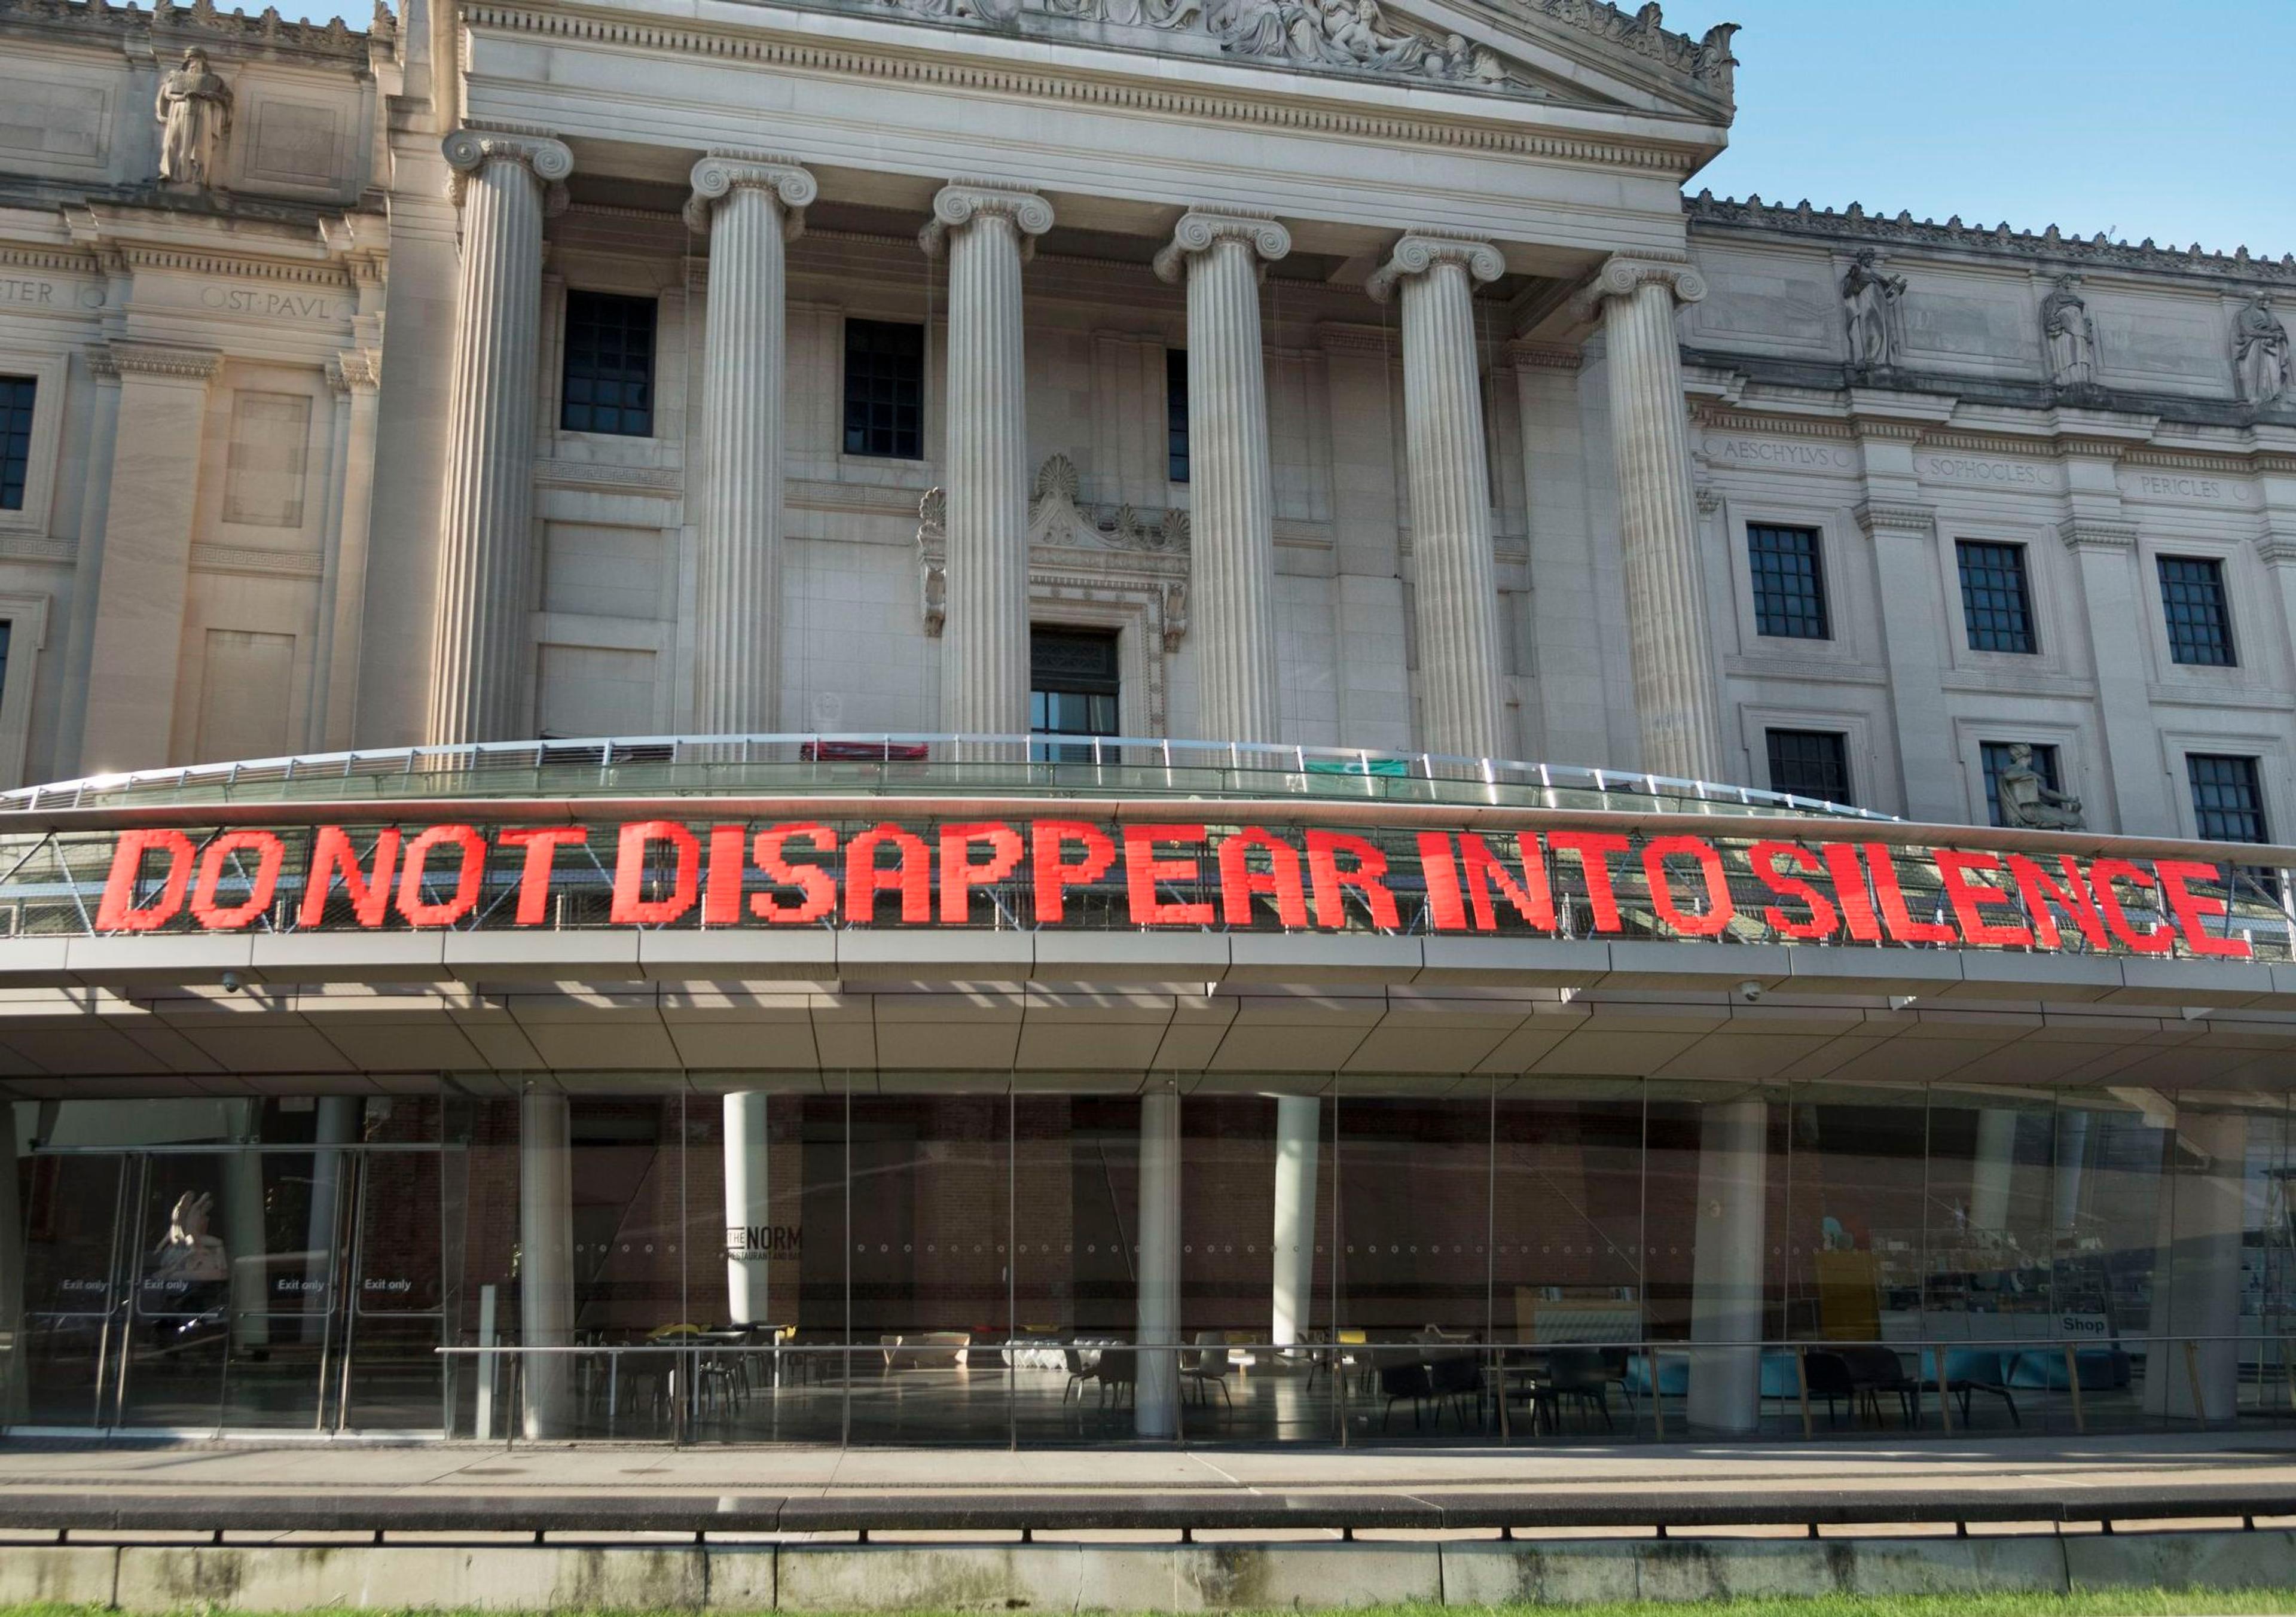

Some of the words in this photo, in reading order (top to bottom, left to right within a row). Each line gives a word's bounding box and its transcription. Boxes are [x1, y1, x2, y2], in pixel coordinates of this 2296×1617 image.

[0, 279, 53, 303] TER
[1724, 441, 1829, 466] AESCHYLVS
[1930, 458, 2036, 483] SOPHOCLES
[2139, 476, 2221, 499] PERICLES
[96, 829, 286, 930] DO
[300, 825, 588, 929] NOT
[609, 819, 1400, 928] DISAPPEAR
[1416, 831, 1734, 936] INTO
[1748, 841, 2251, 957] SILENCE
[727, 1232, 745, 1244] THE
[747, 1227, 803, 1250] NORM
[63, 1279, 83, 1290] Exit
[86, 1279, 107, 1292] only
[144, 1279, 164, 1290] Exit
[165, 1279, 188, 1292] only
[278, 1279, 299, 1290] Exit
[302, 1279, 325, 1292] only
[365, 1279, 386, 1289] Exit
[389, 1279, 411, 1292] only
[2063, 1317, 2105, 1334] Shop
